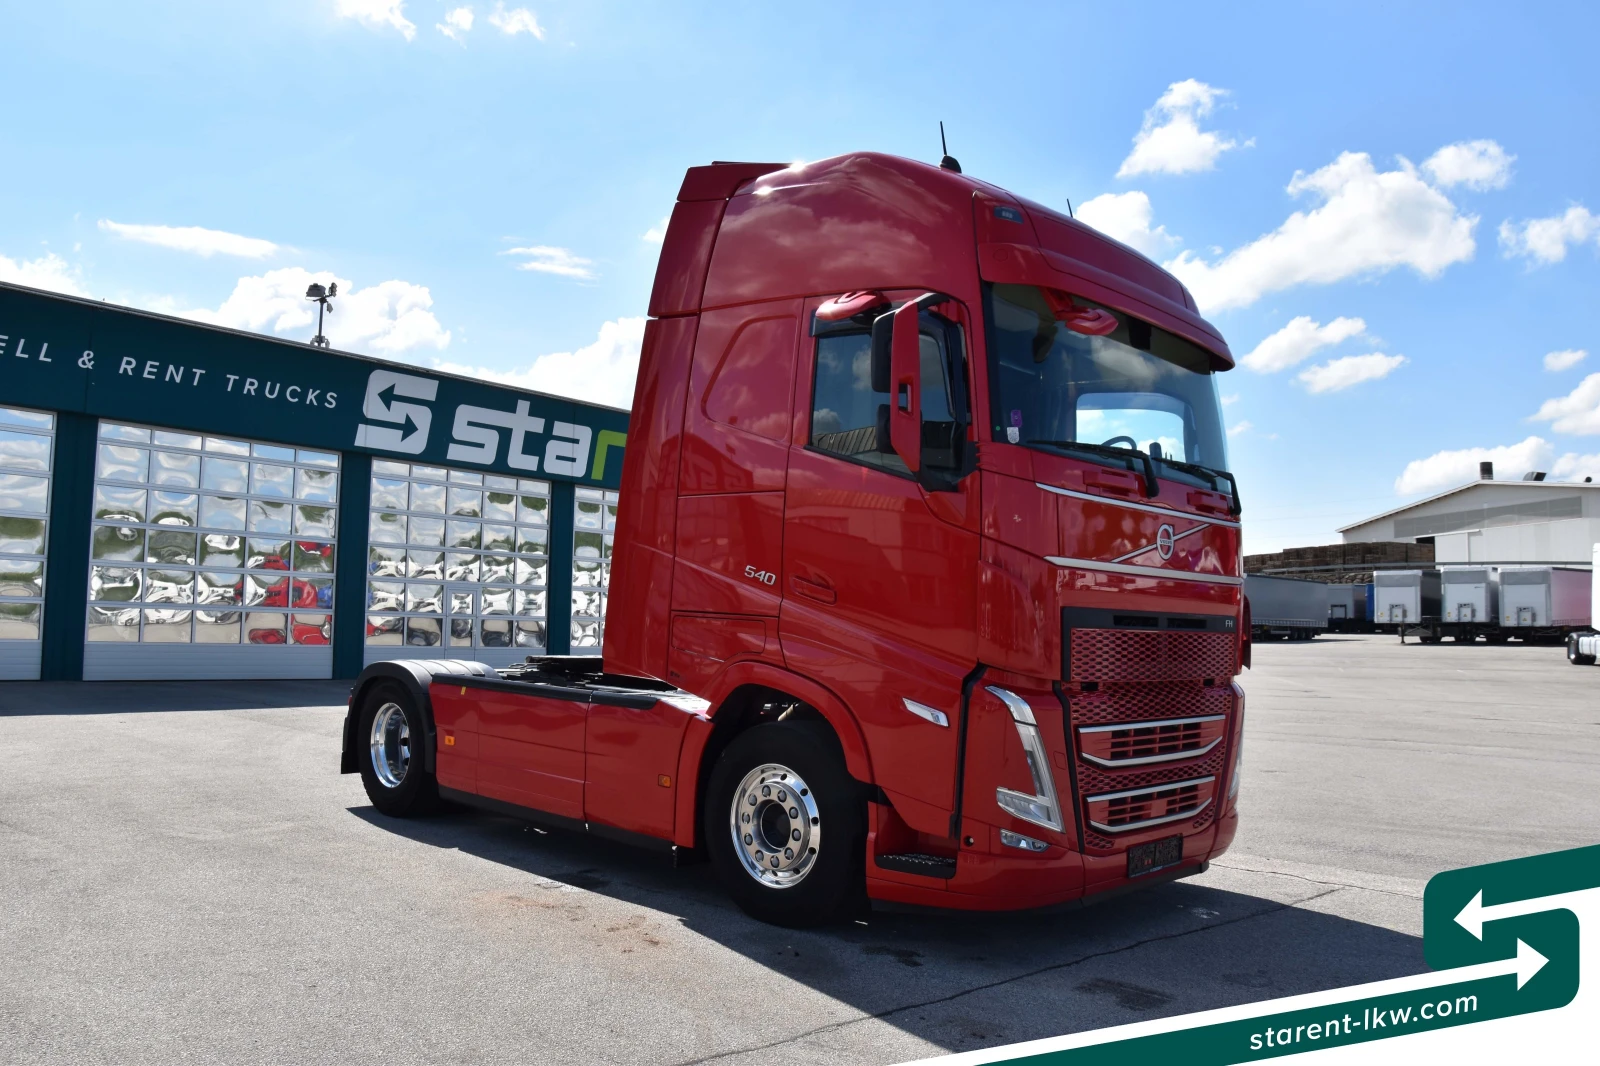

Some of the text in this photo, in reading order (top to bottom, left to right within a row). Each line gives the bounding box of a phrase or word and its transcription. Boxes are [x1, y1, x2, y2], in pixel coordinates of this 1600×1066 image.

[77, 350, 95, 369] &
[118, 356, 206, 386] RENT
[225, 374, 338, 409] TRUCKS
[744, 564, 776, 586] 540
[1225, 619, 1233, 628] FH
